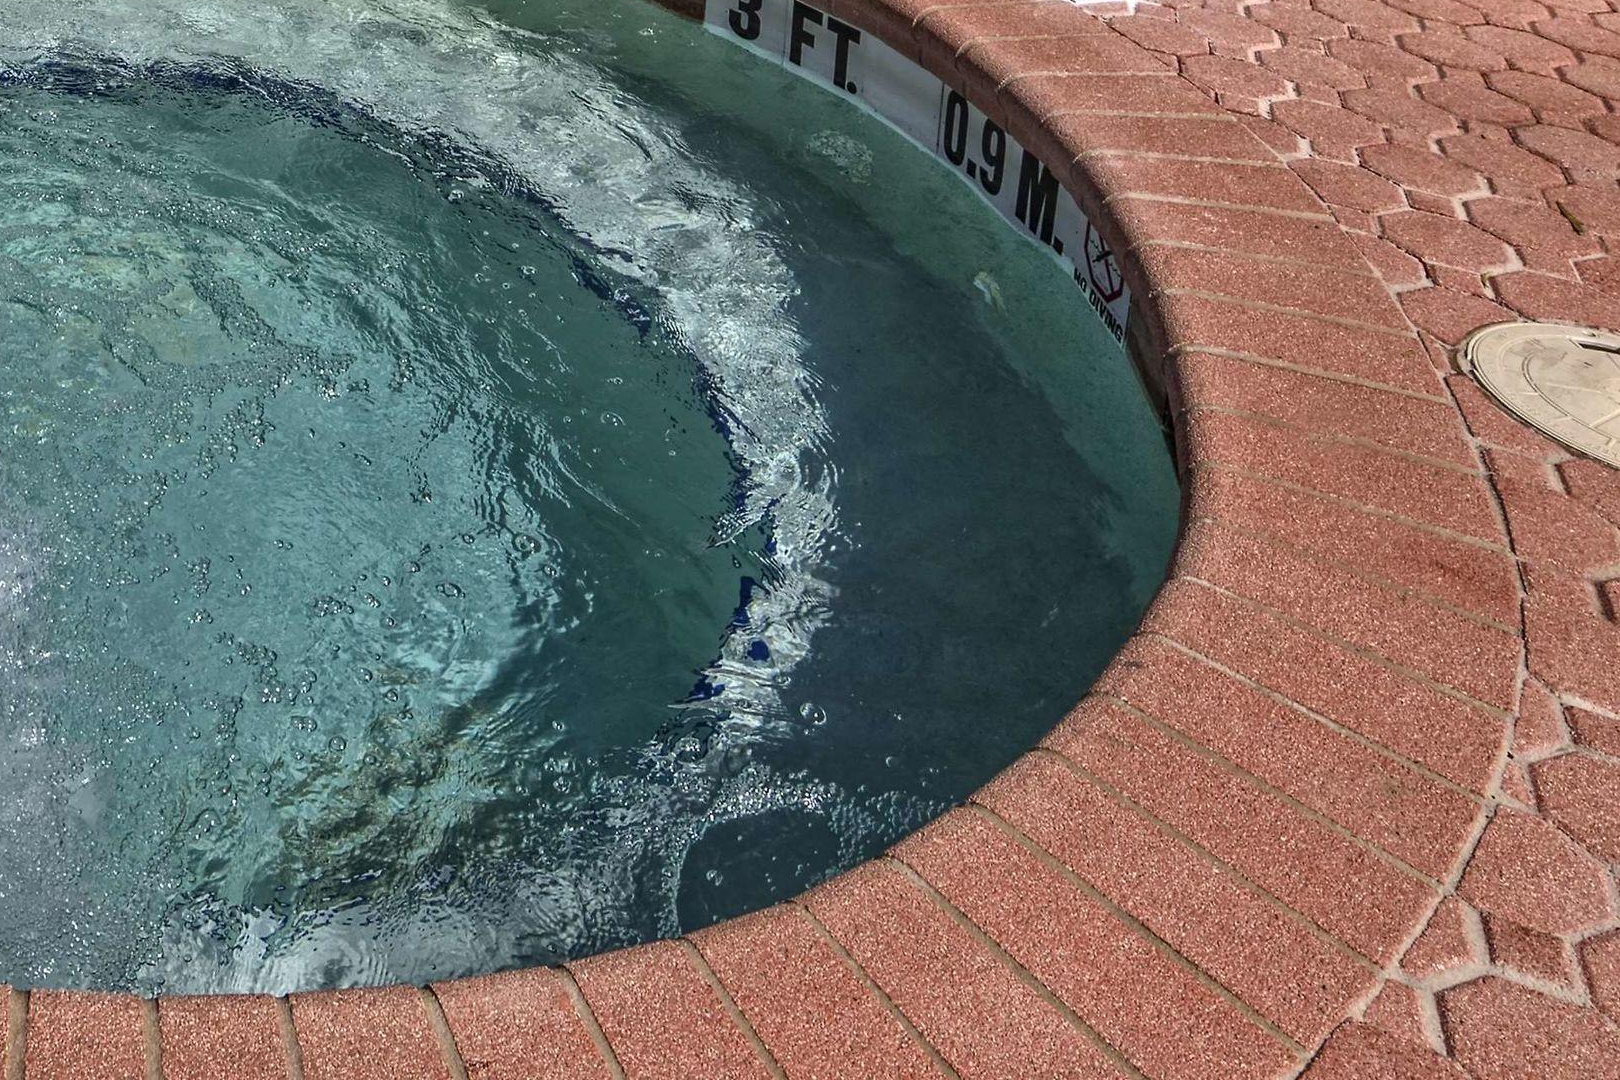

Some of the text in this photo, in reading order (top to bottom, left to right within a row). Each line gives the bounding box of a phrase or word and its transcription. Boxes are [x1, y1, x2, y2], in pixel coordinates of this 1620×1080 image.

[788, 0, 861, 95] FT.
[942, 89, 1064, 256] 0.9 M.
